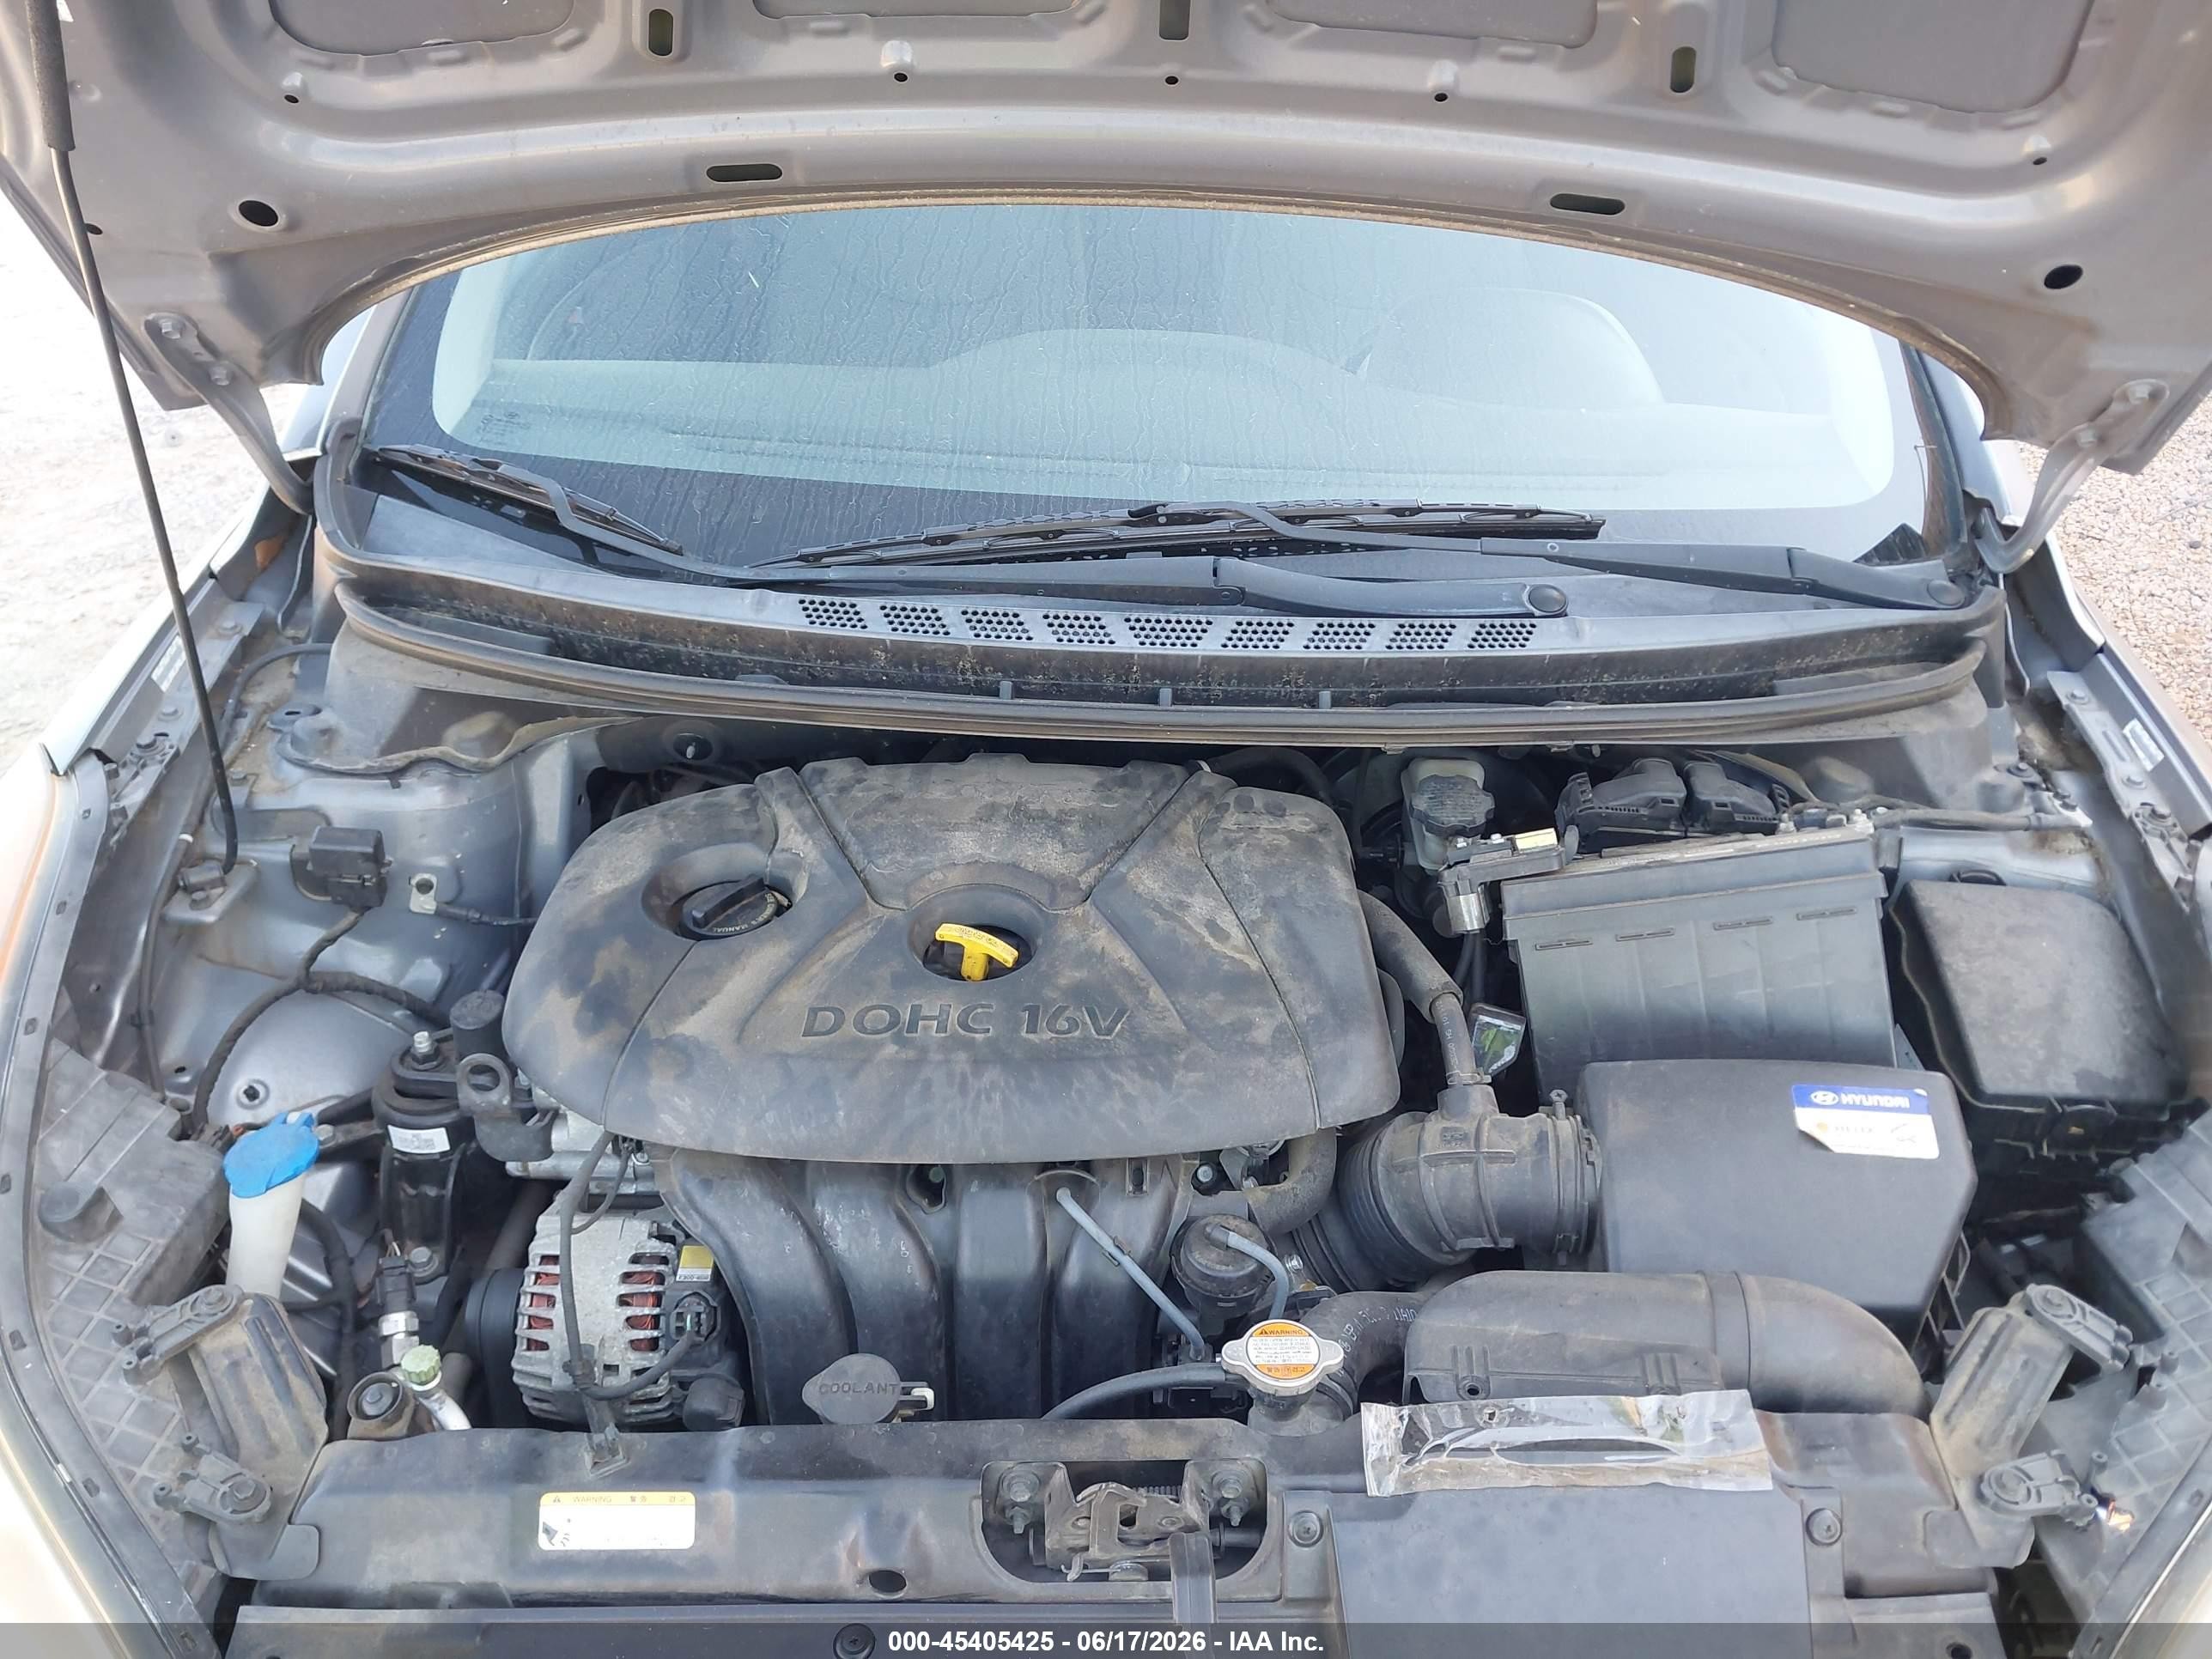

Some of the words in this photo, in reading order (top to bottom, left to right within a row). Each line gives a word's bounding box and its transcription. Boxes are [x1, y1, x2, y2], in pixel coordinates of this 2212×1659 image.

[713, 923, 749, 933] MANUAL
[801, 1002, 995, 1038] DOHC
[1020, 1003, 1132, 1040] 16V
[1840, 1091, 1911, 1109] HYUNDAI
[818, 1382, 899, 1395] COOLANT
[573, 1495, 612, 1504] WARNING
